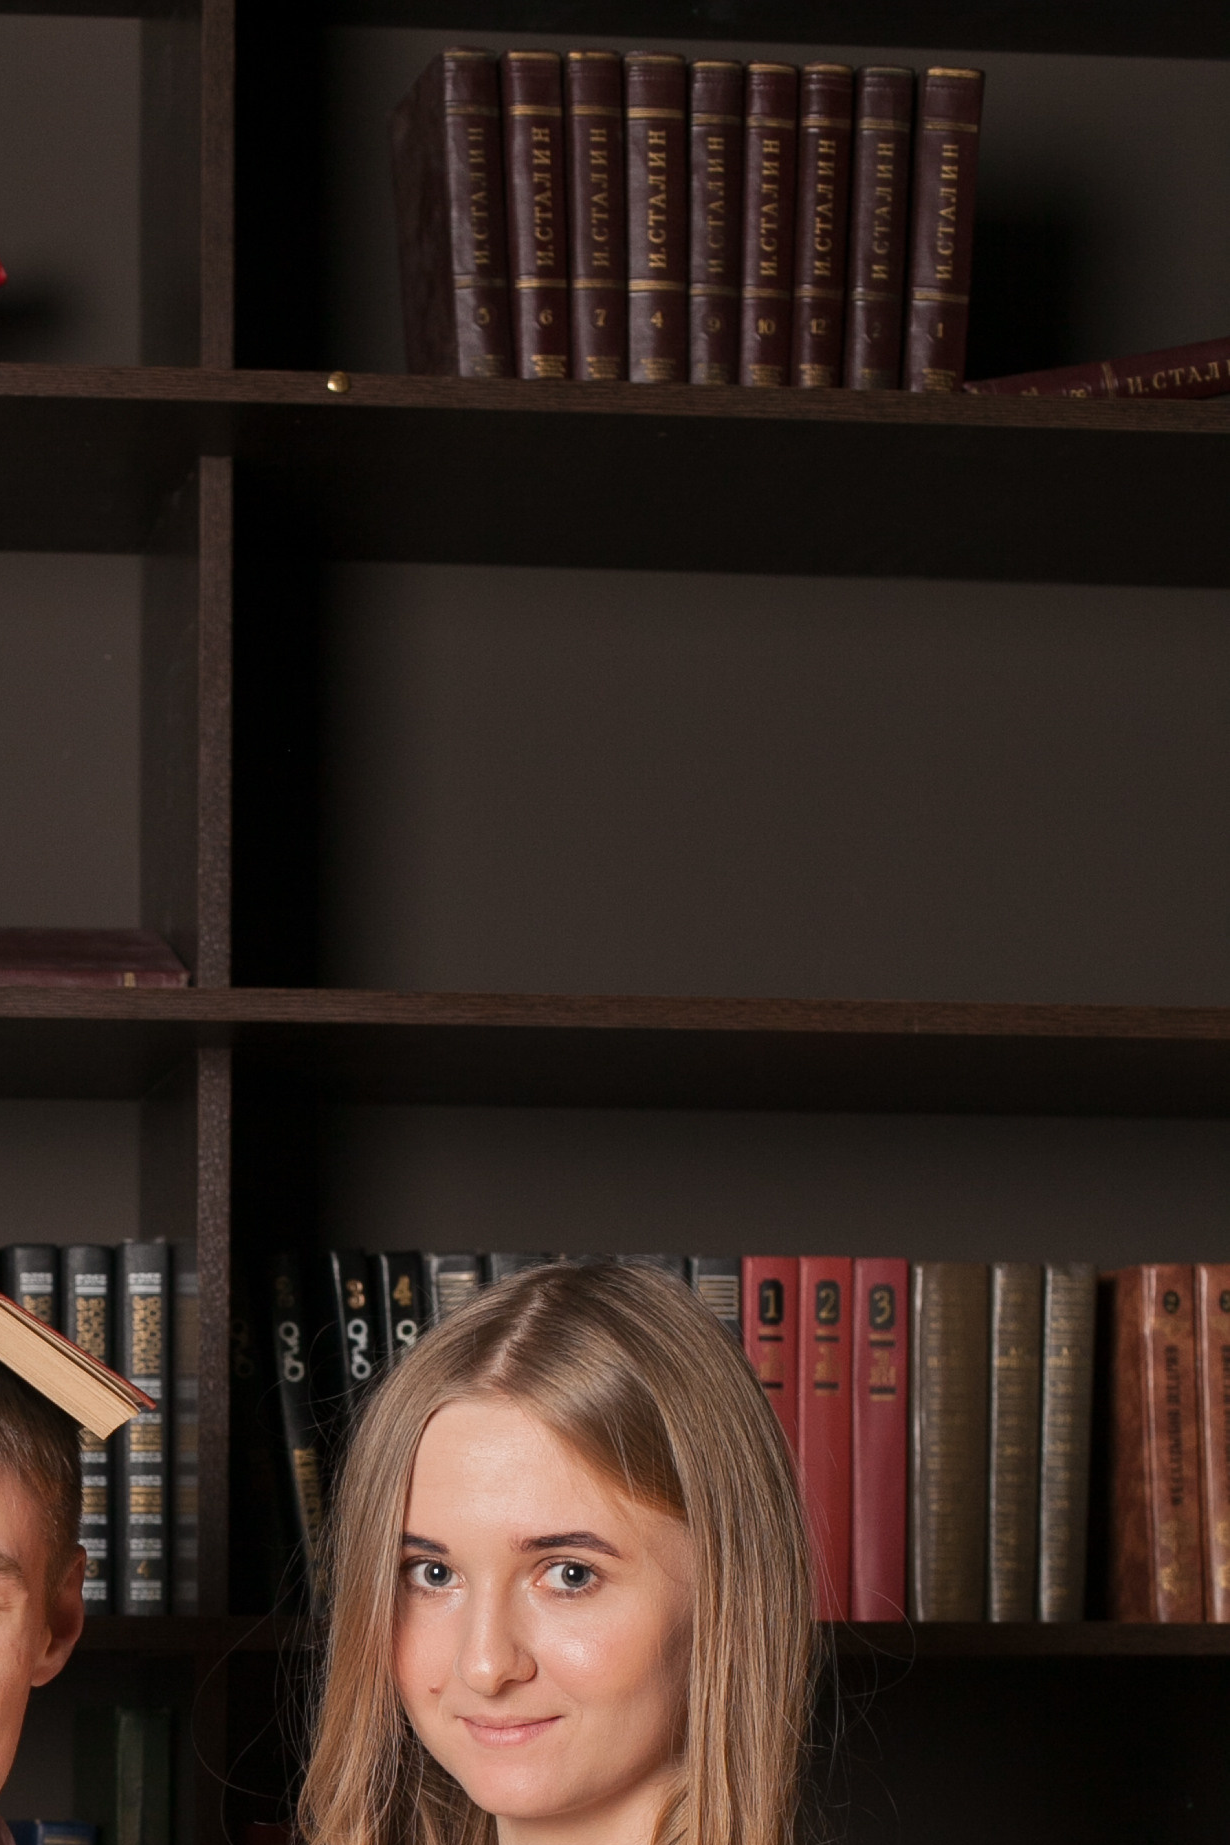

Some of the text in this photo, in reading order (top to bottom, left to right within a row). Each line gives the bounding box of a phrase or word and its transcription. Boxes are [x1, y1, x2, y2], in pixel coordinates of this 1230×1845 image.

[539, 308, 553, 325] 6
[594, 308, 607, 327] 7
[651, 311, 664, 328] 4
[1126, 358, 1230, 394] И.СТАЛ
[393, 1275, 412, 1307] 4
[762, 1288, 779, 1319] 1
[818, 1287, 837, 1319] 2
[873, 1290, 892, 1325] 3
[136, 1559, 151, 1579] 4
